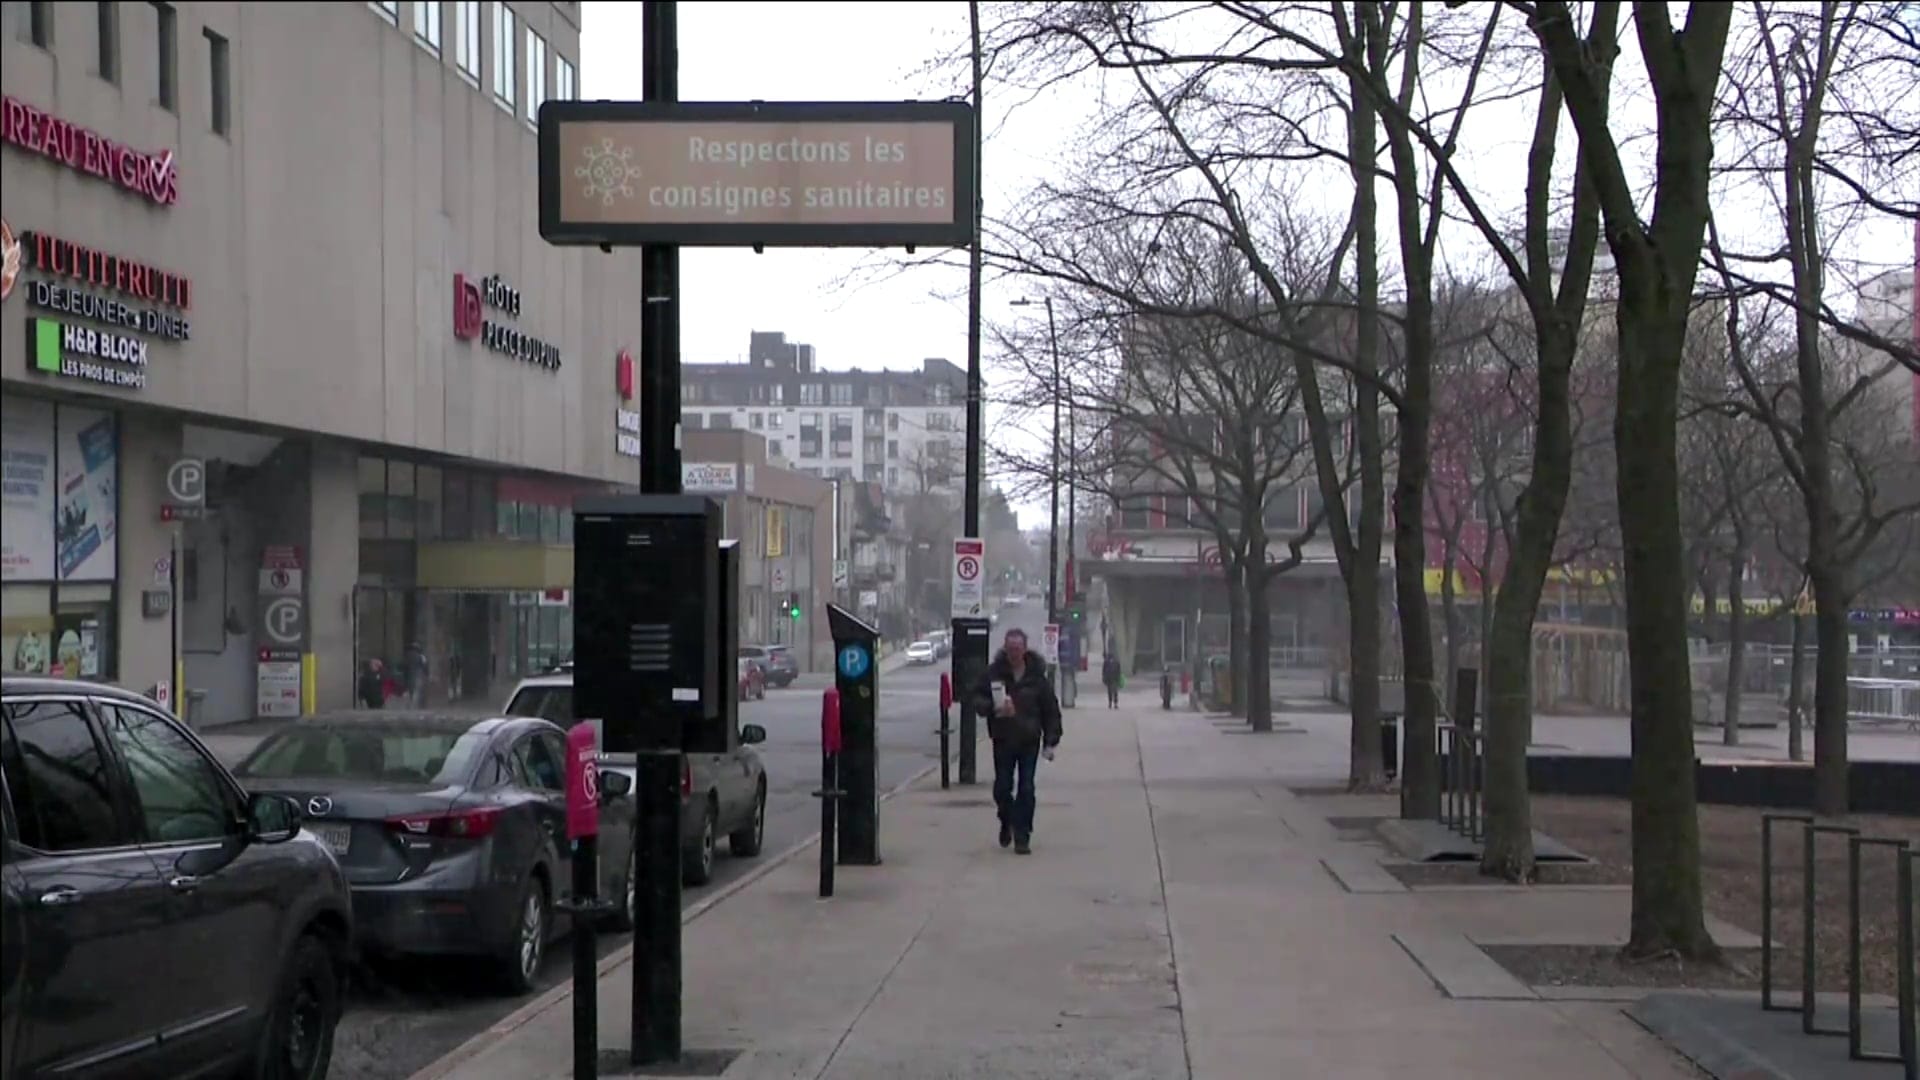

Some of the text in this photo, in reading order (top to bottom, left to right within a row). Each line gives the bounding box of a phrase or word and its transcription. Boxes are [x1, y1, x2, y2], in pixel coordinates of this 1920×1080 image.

[83, 131, 113, 180] EN
[118, 149, 177, 204] GROS
[688, 135, 905, 167] Respectons les
[649, 180, 946, 215] consignes sanitaires
[34, 231, 193, 311] TUTTI FRUTTI
[63, 323, 148, 366] H&R BLOCK
[486, 320, 522, 358] PLACE
[61, 359, 79, 377] LES
[79, 364, 103, 382] PROS
[105, 369, 114, 383] DE
